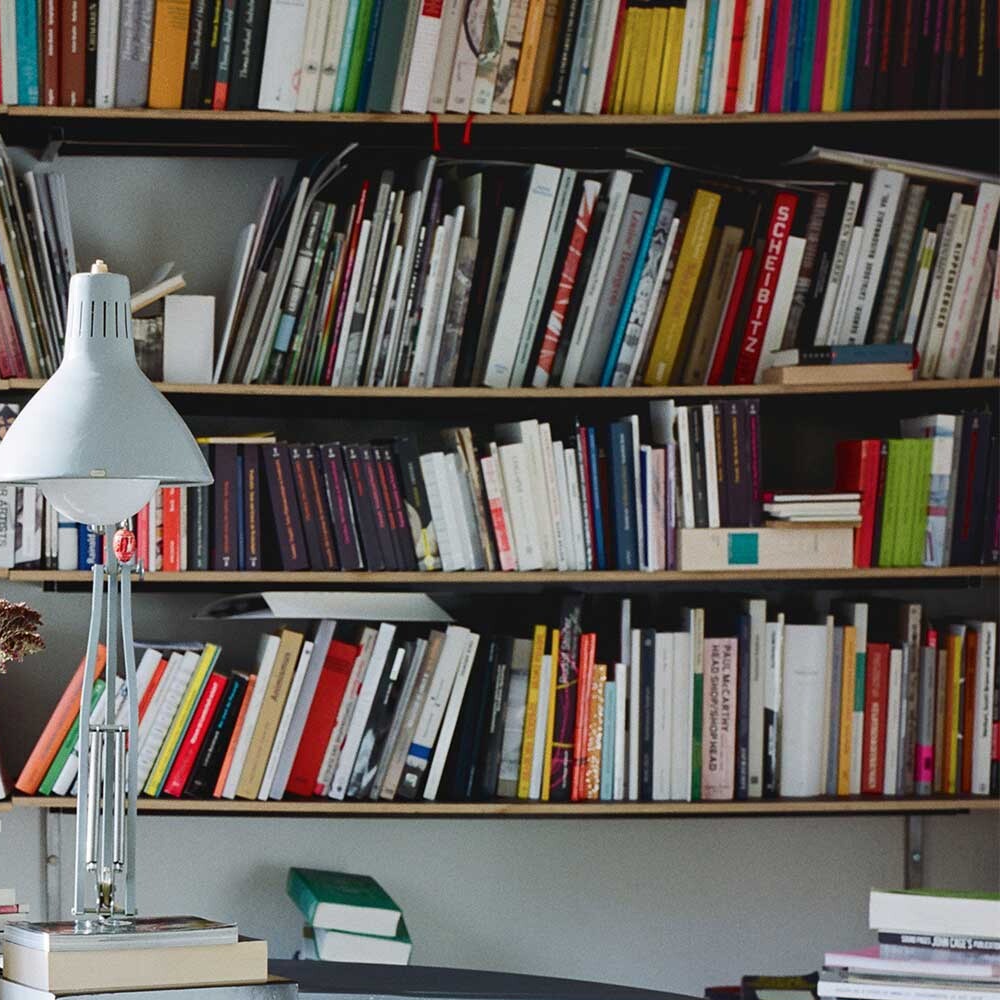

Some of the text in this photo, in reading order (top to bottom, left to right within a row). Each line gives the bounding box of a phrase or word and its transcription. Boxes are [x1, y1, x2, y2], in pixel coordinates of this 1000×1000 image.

[745, 207, 790, 352] SCHEIBITZ
[86, 534, 96, 564] Rainald
[711, 644, 719, 674] HEAD
[721, 644, 731, 732] PAUL McCARTHY
